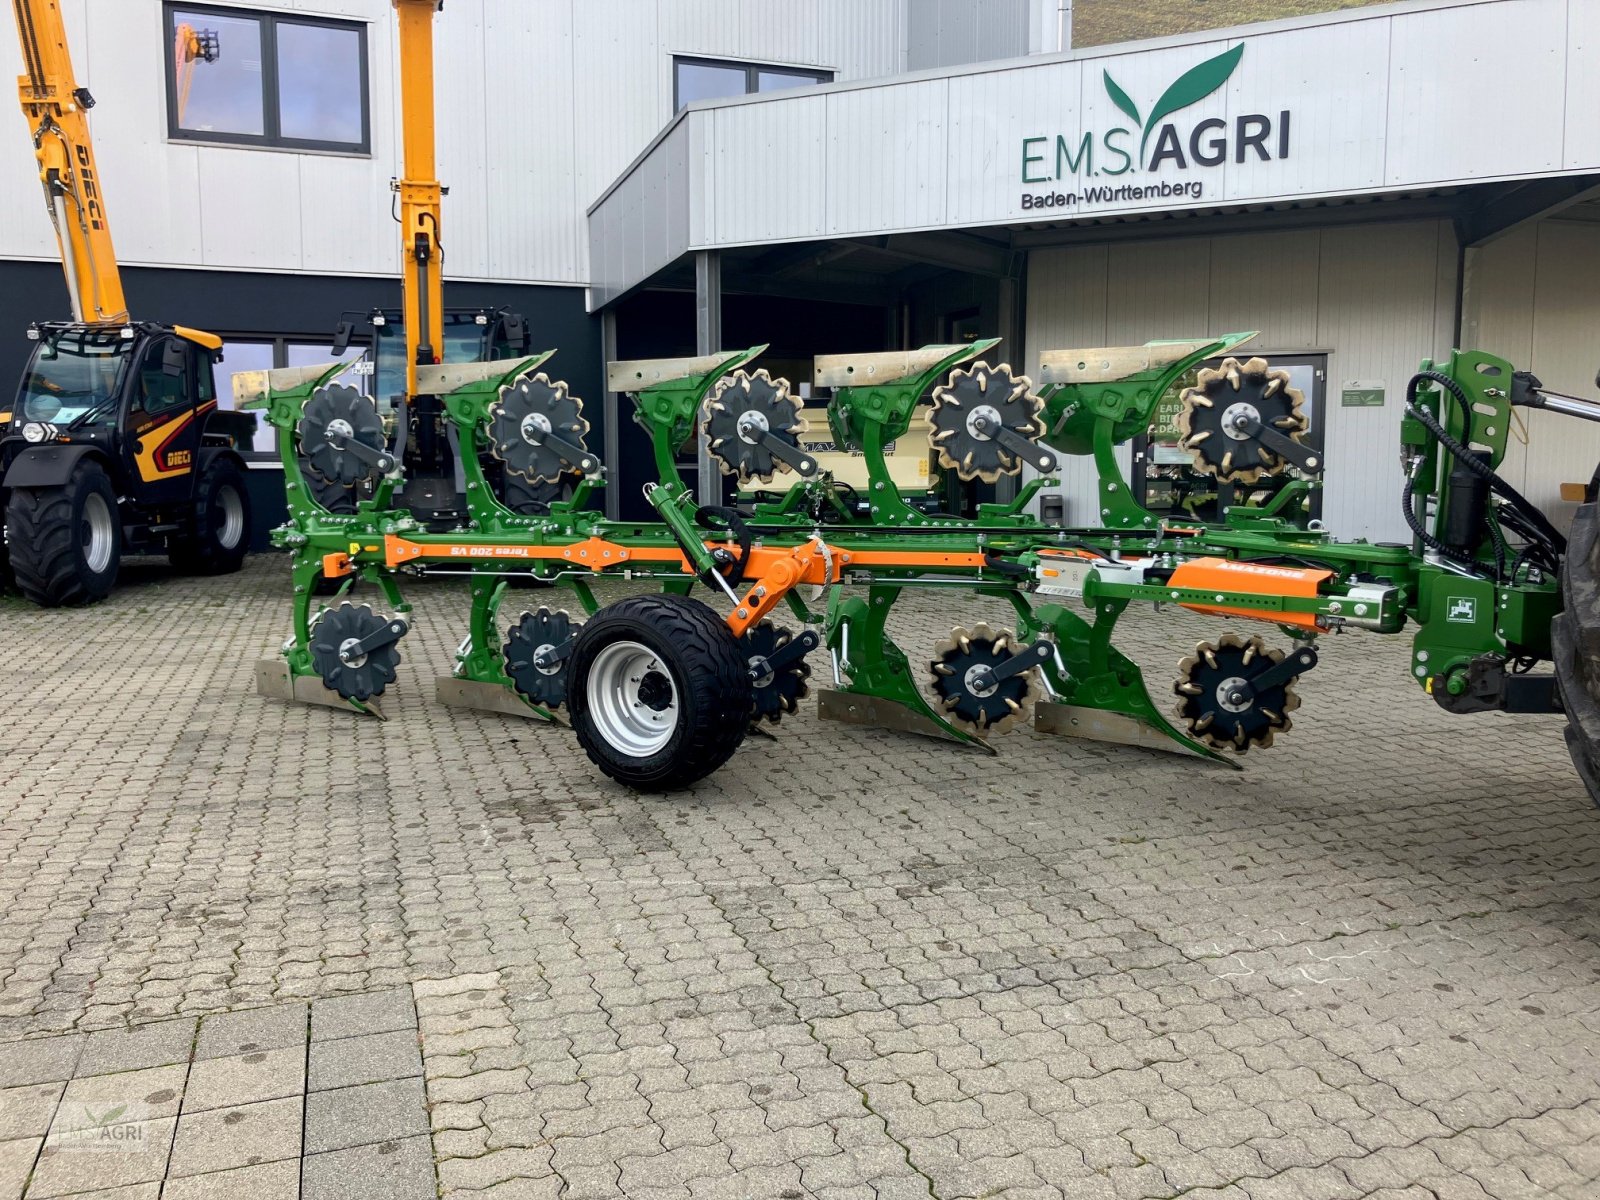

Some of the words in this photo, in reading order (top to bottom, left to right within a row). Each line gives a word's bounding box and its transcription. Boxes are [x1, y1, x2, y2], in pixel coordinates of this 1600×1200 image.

[1022, 127, 1135, 183] E.M.S.
[1148, 110, 1290, 172] AGRI
[1021, 180, 1203, 210] Baden-Württemberg
[1160, 424, 1180, 433] DEA
[451, 547, 467, 556] VS
[469, 547, 493, 556] 200
[495, 547, 529, 557] Teres
[1216, 562, 1306, 580] AMAZONE
